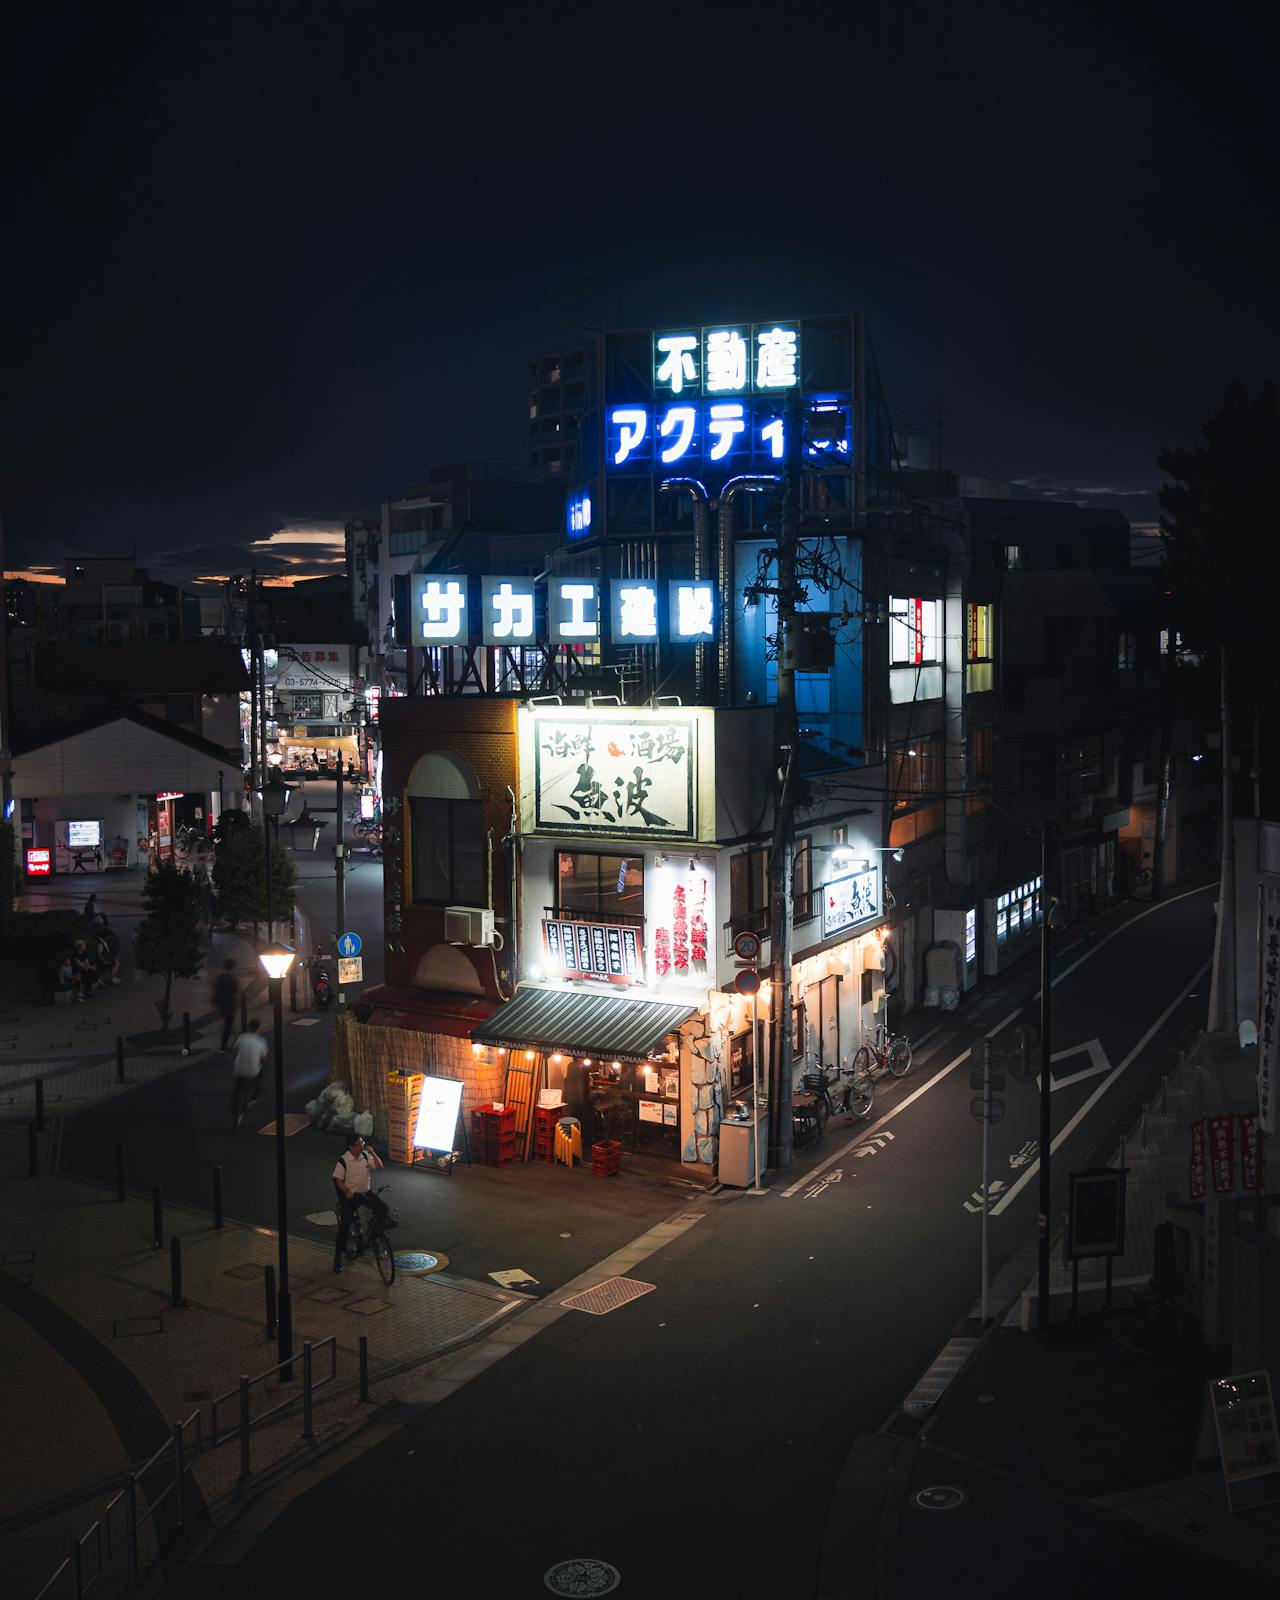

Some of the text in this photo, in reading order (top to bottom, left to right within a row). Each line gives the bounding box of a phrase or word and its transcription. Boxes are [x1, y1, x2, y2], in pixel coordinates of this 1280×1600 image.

[657, 327, 797, 393] 不動産
[542, 725, 686, 764] 海鮮 酒場
[550, 763, 675, 827] 魚波
[741, 940, 755, 952] 20
[495, 1039, 526, 1050] UONAMI
[553, 1047, 587, 1059] UONAMI
